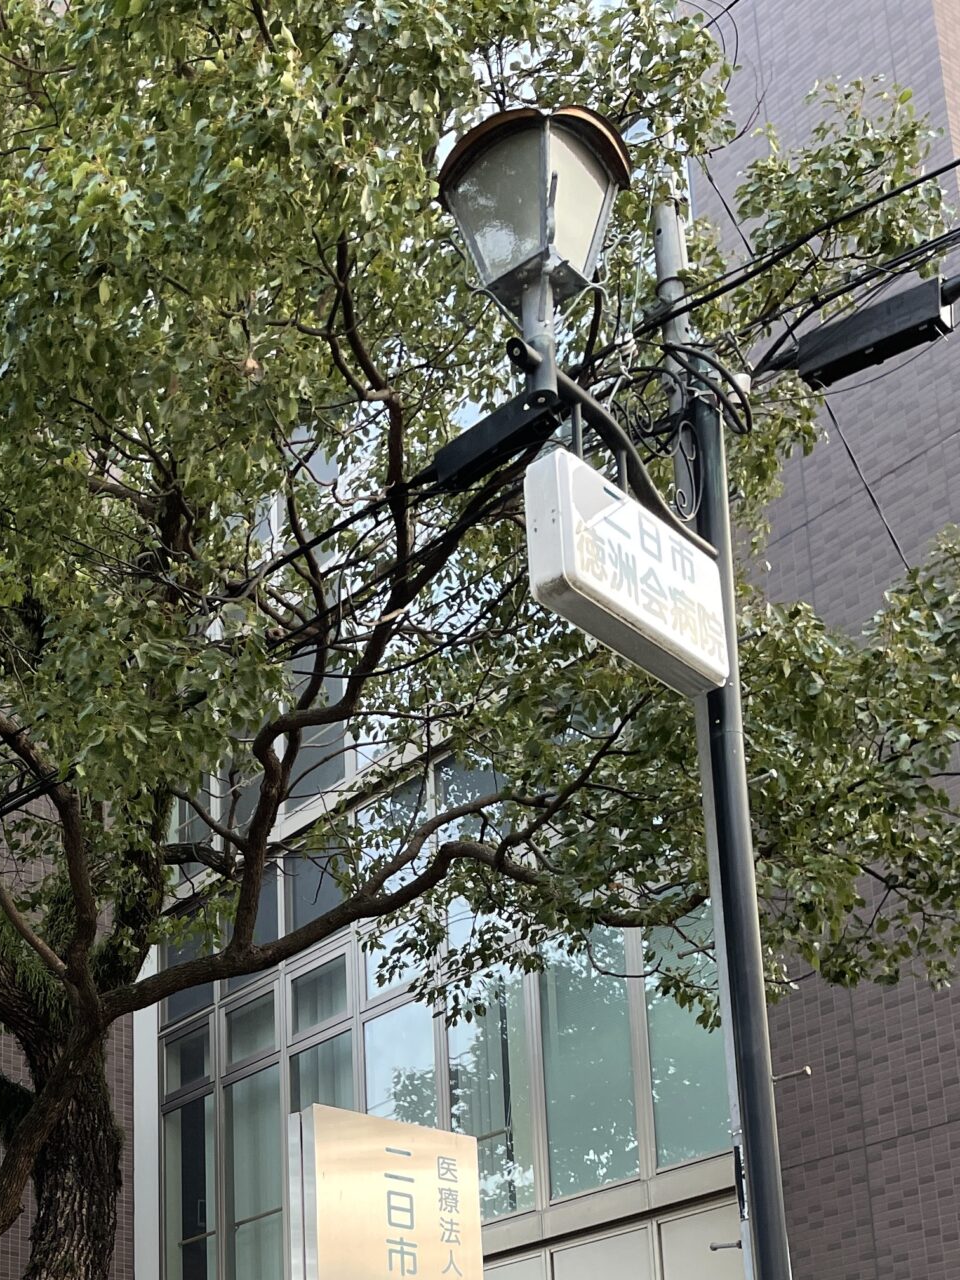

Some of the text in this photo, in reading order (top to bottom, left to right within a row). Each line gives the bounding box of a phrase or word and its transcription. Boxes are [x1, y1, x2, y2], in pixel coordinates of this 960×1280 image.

[575, 521, 726, 665] 徳洲会病院
[436, 1155, 463, 1278] 医療法人
